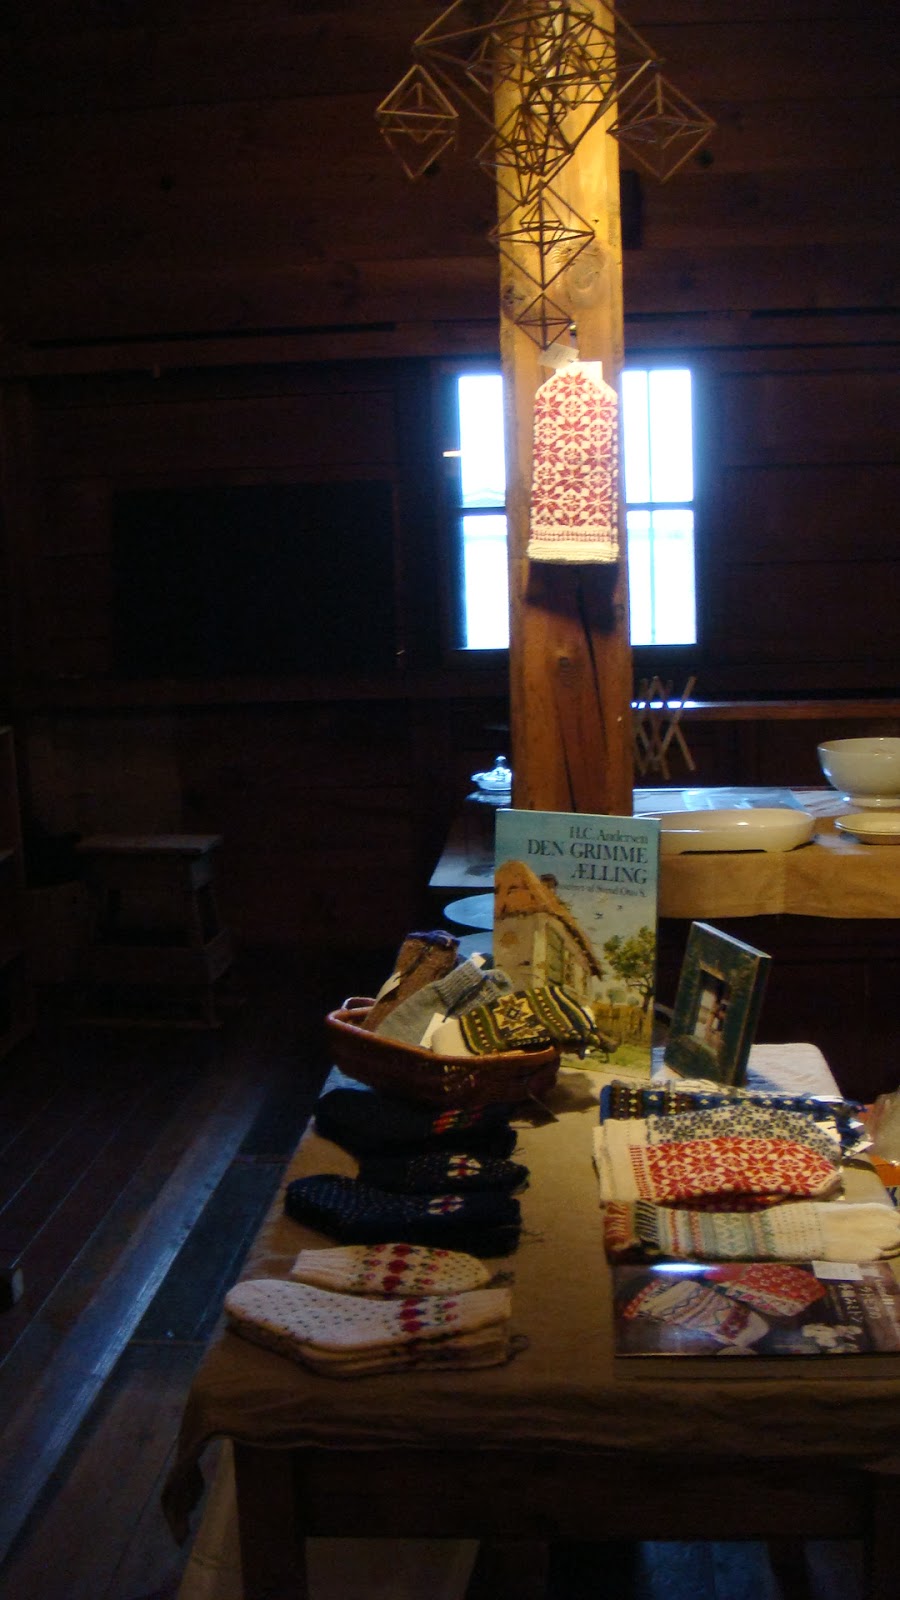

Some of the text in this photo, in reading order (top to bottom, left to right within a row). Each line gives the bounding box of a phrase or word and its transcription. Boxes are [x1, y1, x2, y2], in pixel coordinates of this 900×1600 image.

[598, 829, 649, 844] Andersen
[528, 839, 648, 864] DEN GRIMME
[571, 863, 647, 885] ÆLLING
